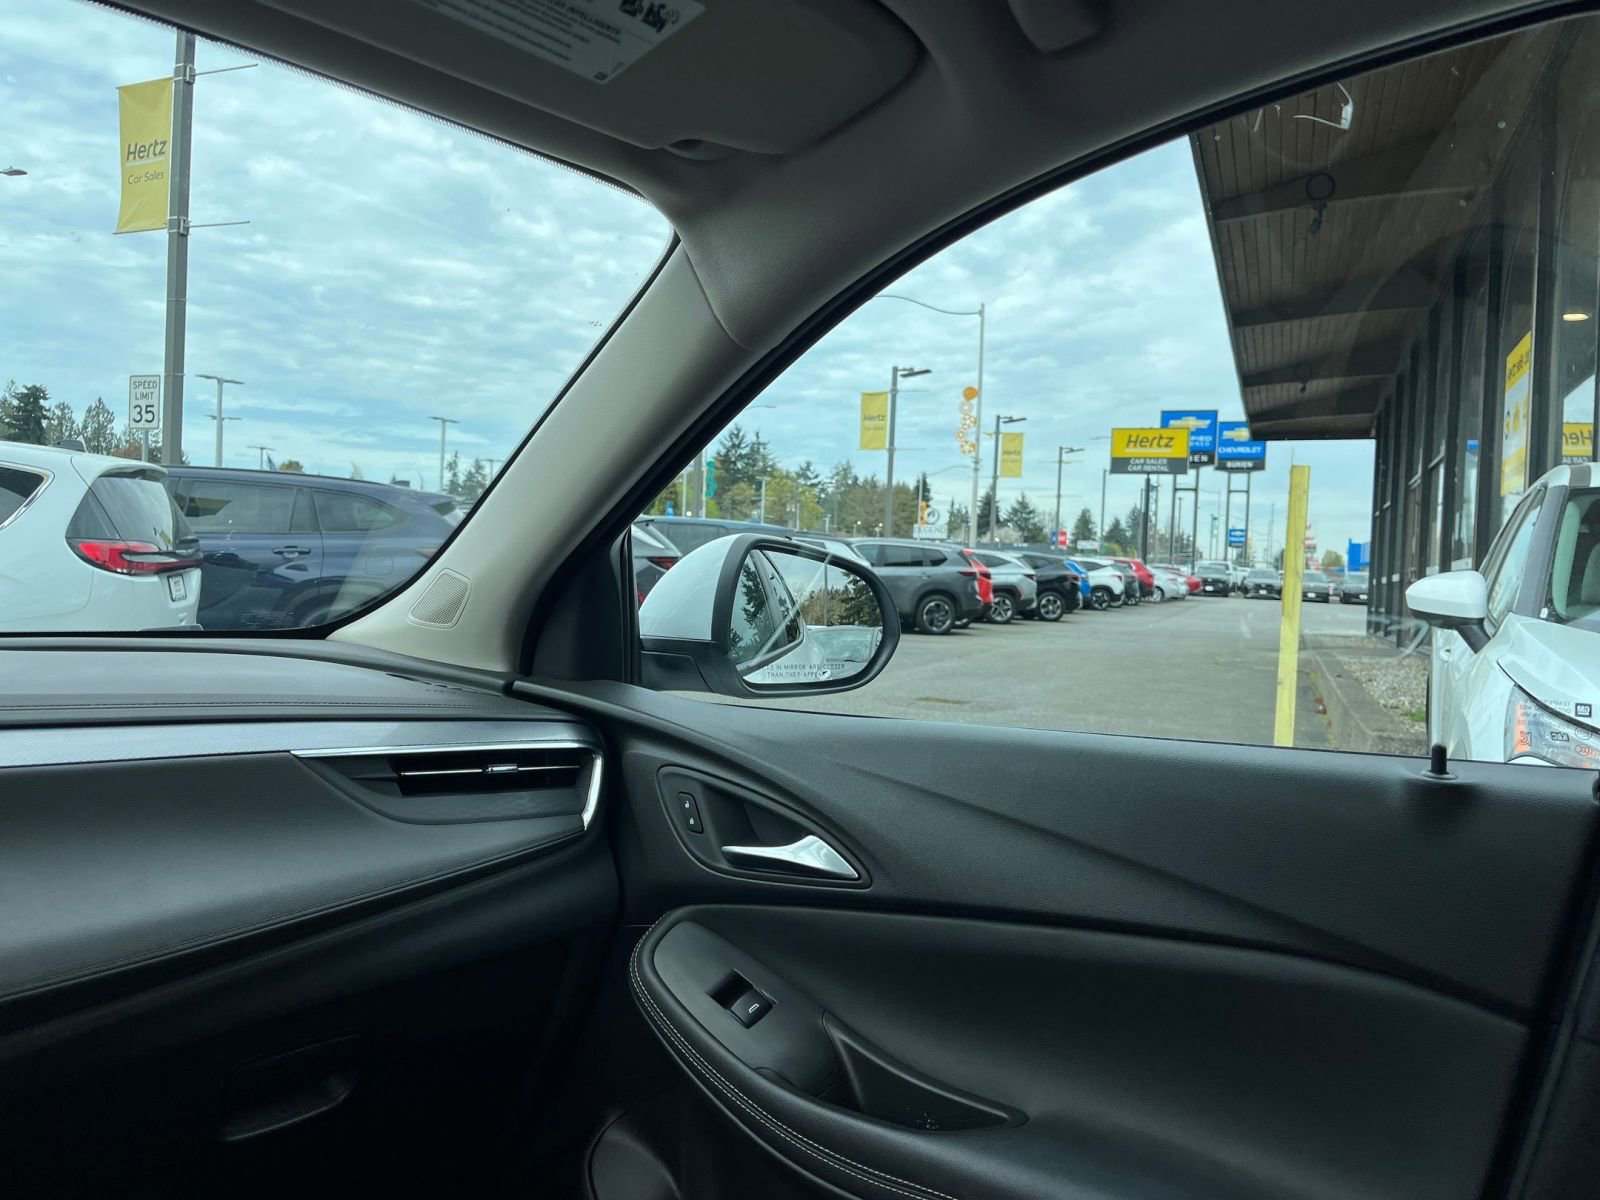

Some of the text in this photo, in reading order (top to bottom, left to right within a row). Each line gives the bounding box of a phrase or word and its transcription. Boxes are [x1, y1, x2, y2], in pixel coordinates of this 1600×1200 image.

[126, 139, 167, 161] Hertz
[127, 170, 164, 185] Car Sales
[132, 380, 158, 390] SPEED
[134, 391, 154, 401] LIMIT
[132, 404, 155, 423] 35
[1125, 434, 1174, 449] Hertz
